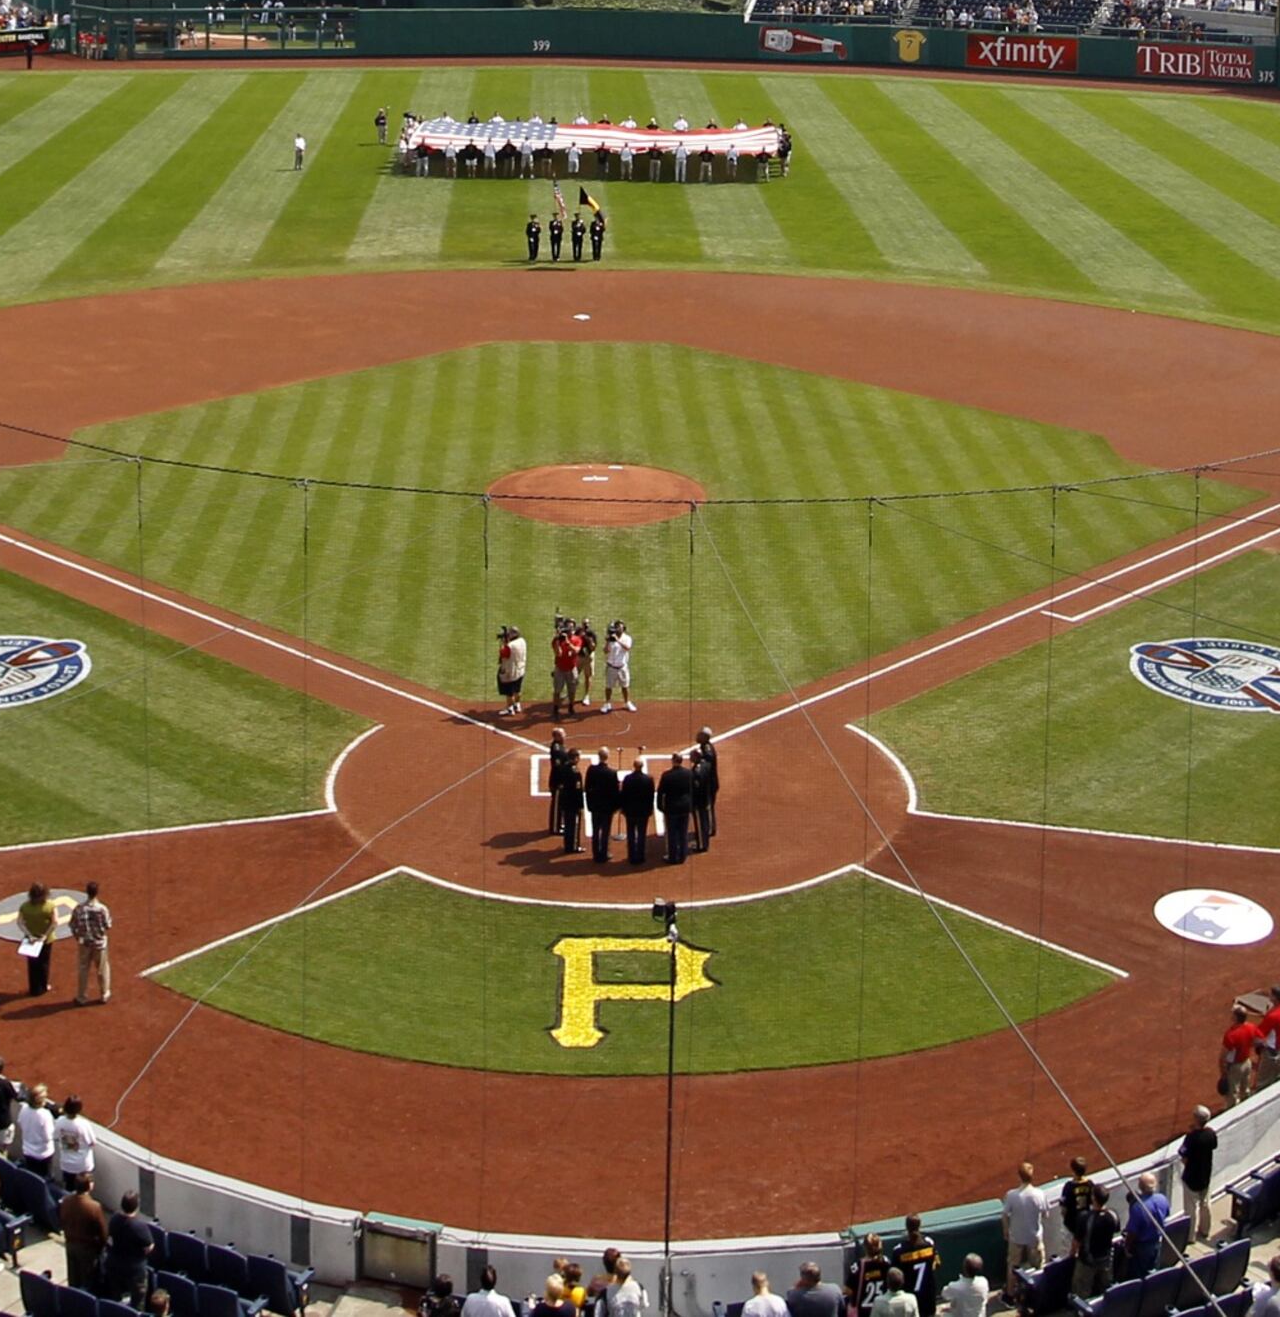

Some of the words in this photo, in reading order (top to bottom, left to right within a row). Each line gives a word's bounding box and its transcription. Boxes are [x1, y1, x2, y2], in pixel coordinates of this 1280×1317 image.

[532, 40, 551, 51] 399
[906, 38, 913, 49] 7
[979, 36, 1065, 69] xfinity
[1137, 45, 1202, 75] TRIB
[1207, 49, 1252, 65] TOTAL
[1210, 64, 1252, 79] MEDIA
[1258, 70, 1275, 83] 375
[548, 935, 720, 1049] P
[913, 1262, 926, 1292] 7
